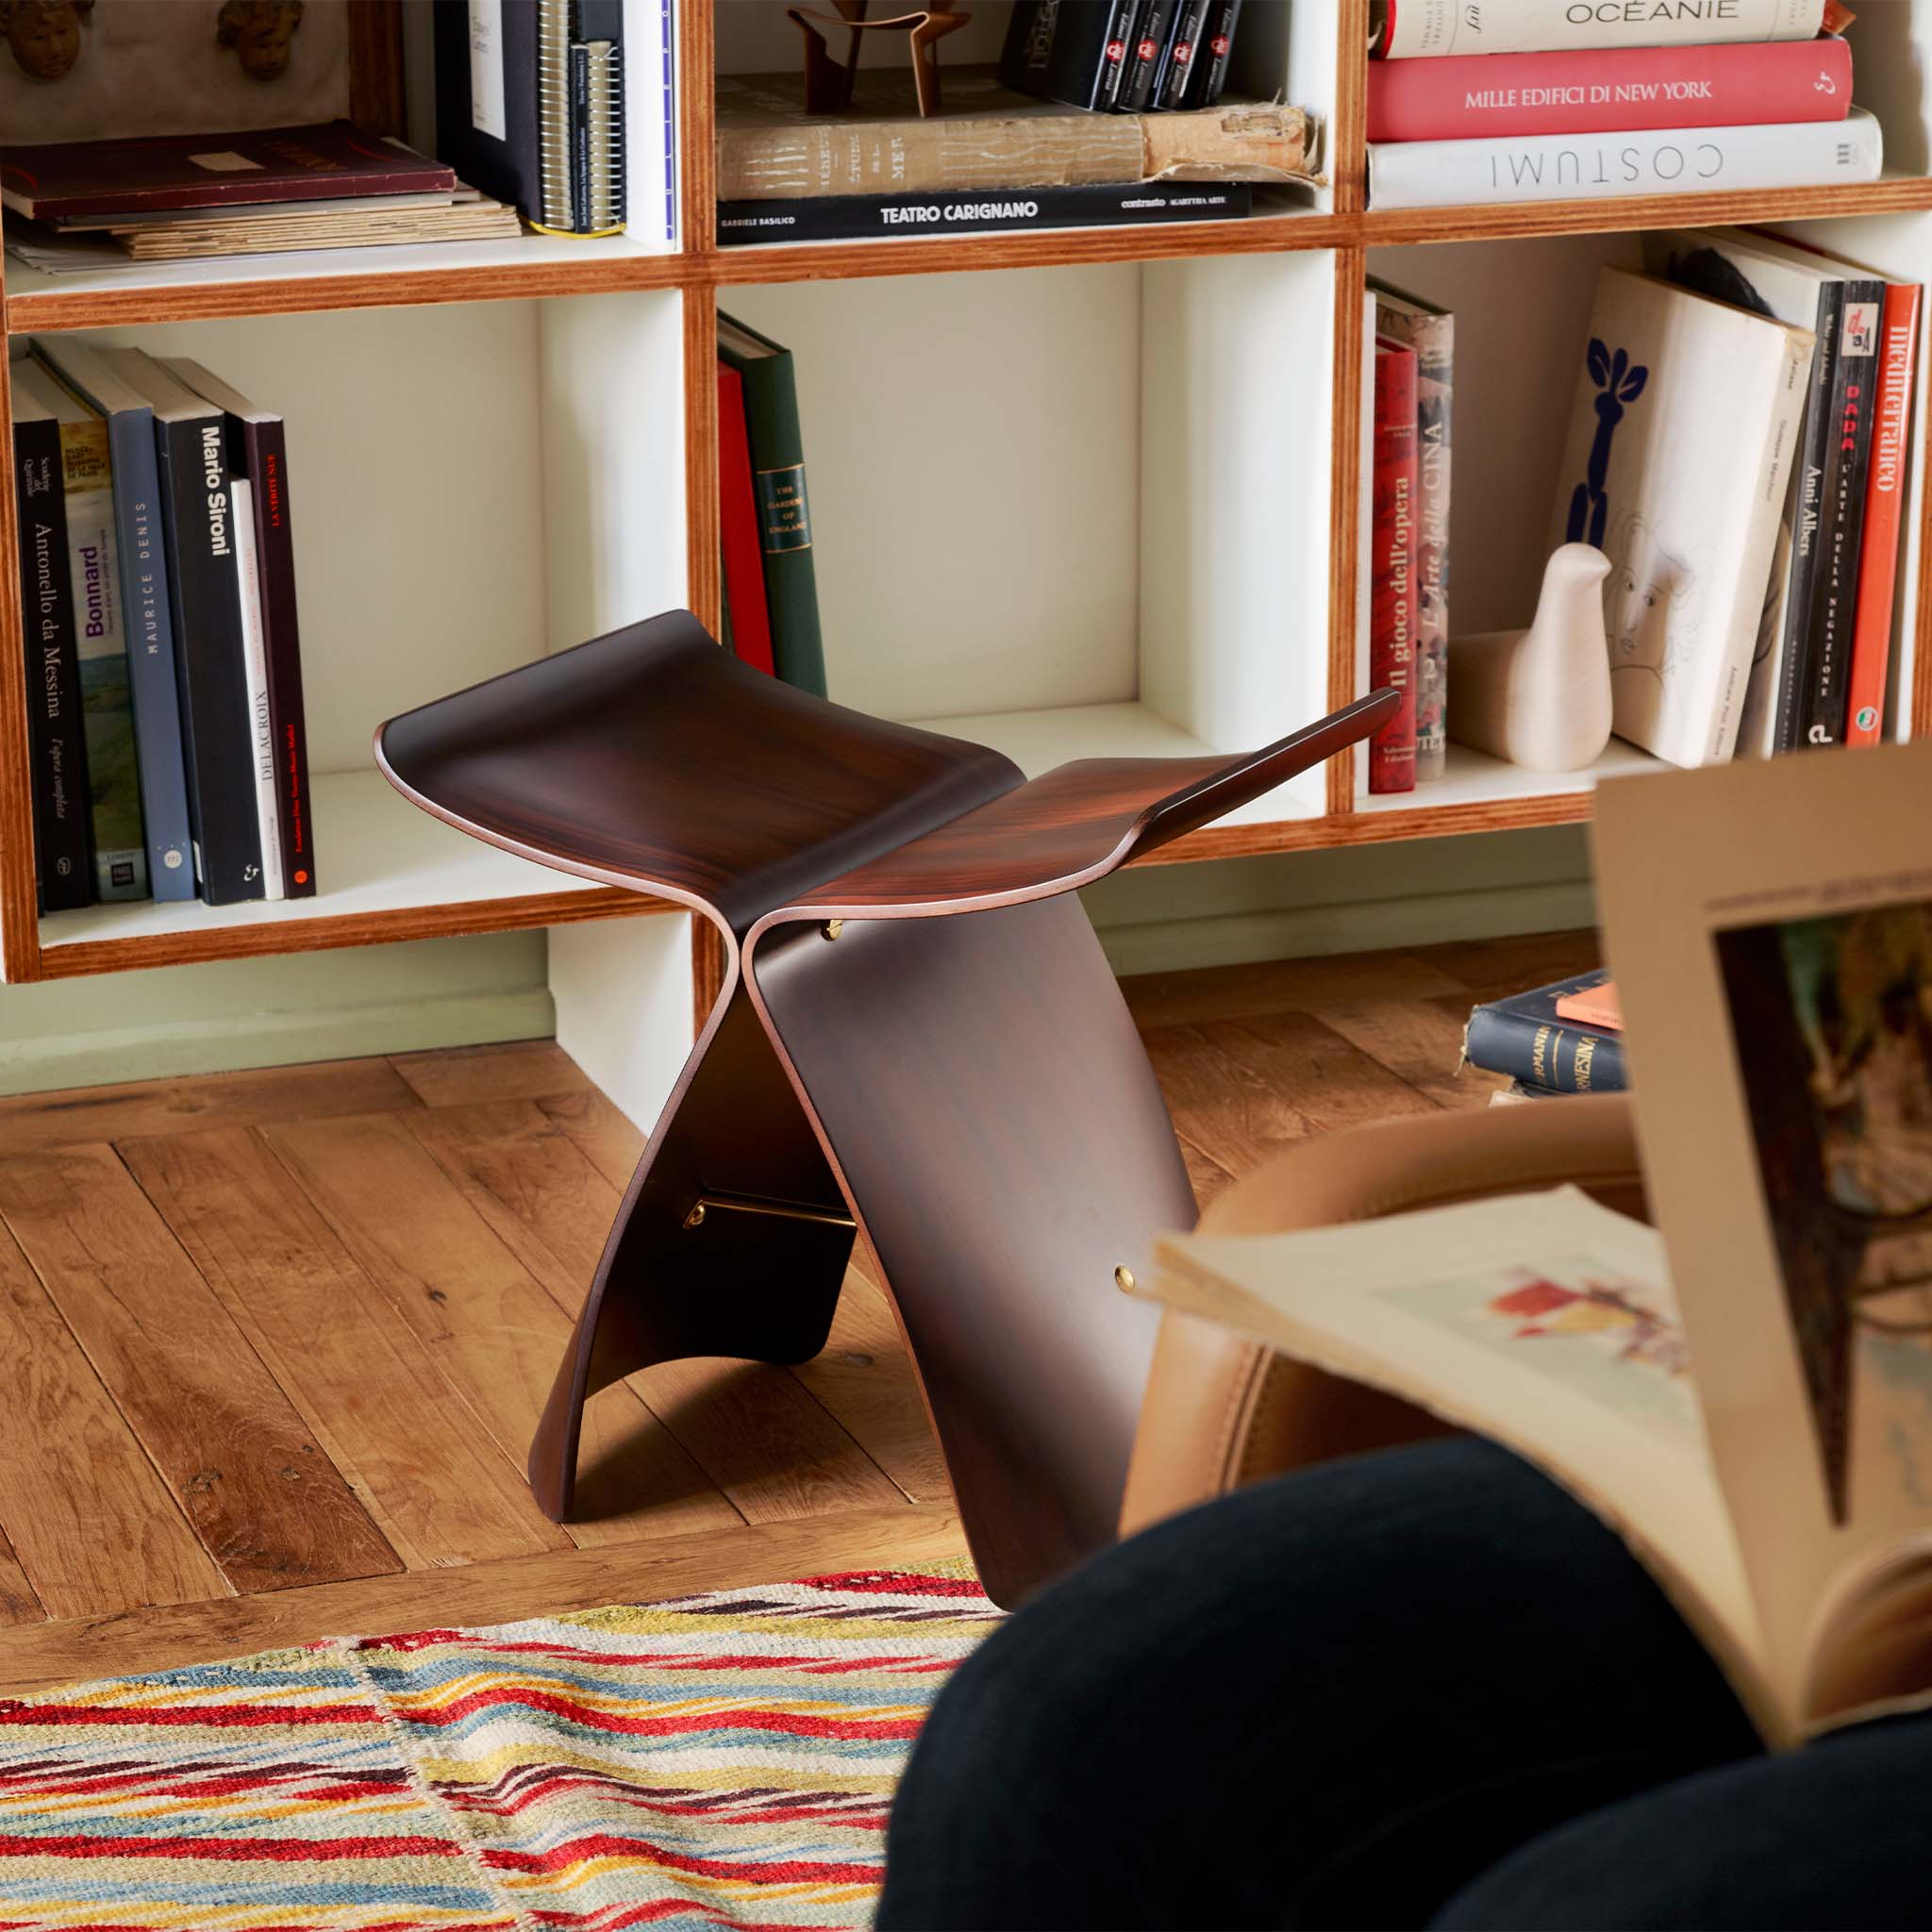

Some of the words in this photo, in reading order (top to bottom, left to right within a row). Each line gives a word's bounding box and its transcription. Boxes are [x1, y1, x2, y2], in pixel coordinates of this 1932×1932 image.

[1566, 0, 1740, 24] OCÉANIE
[1464, 88, 1517, 109] MILLE
[1521, 85, 1586, 107] EDIFICI
[1591, 84, 1612, 104] DI
[1615, 82, 1659, 103] NEW
[1660, 79, 1713, 101] YORK
[1491, 143, 1725, 188] COSTUMI
[721, 218, 757, 227] GABRIELE
[759, 216, 795, 225] BASILICO
[881, 205, 941, 224] TEATRO
[943, 201, 1039, 222] CARIGNANO
[1840, 386, 1860, 450] DADA
[201, 425, 223, 489] Mario
[1423, 422, 1443, 491] CINA
[1803, 464, 1824, 509] Anni
[135, 502, 151, 559] DENIS
[207, 491, 230, 557] Sironi
[1390, 476, 1411, 594] dell'opera
[1793, 510, 1819, 557] Albers
[35, 524, 58, 614] Antonello
[1830, 531, 1846, 588] DELLA
[78, 545, 105, 638] Bonnard
[140, 573, 158, 655] MAURICE
[41, 619, 57, 641] da
[1390, 600, 1411, 663] gioco
[1820, 596, 1839, 697] NEGAZIONE
[42, 646, 63, 719] Messina
[1390, 669, 1408, 687] Il
[255, 690, 274, 782] DELACROIX
